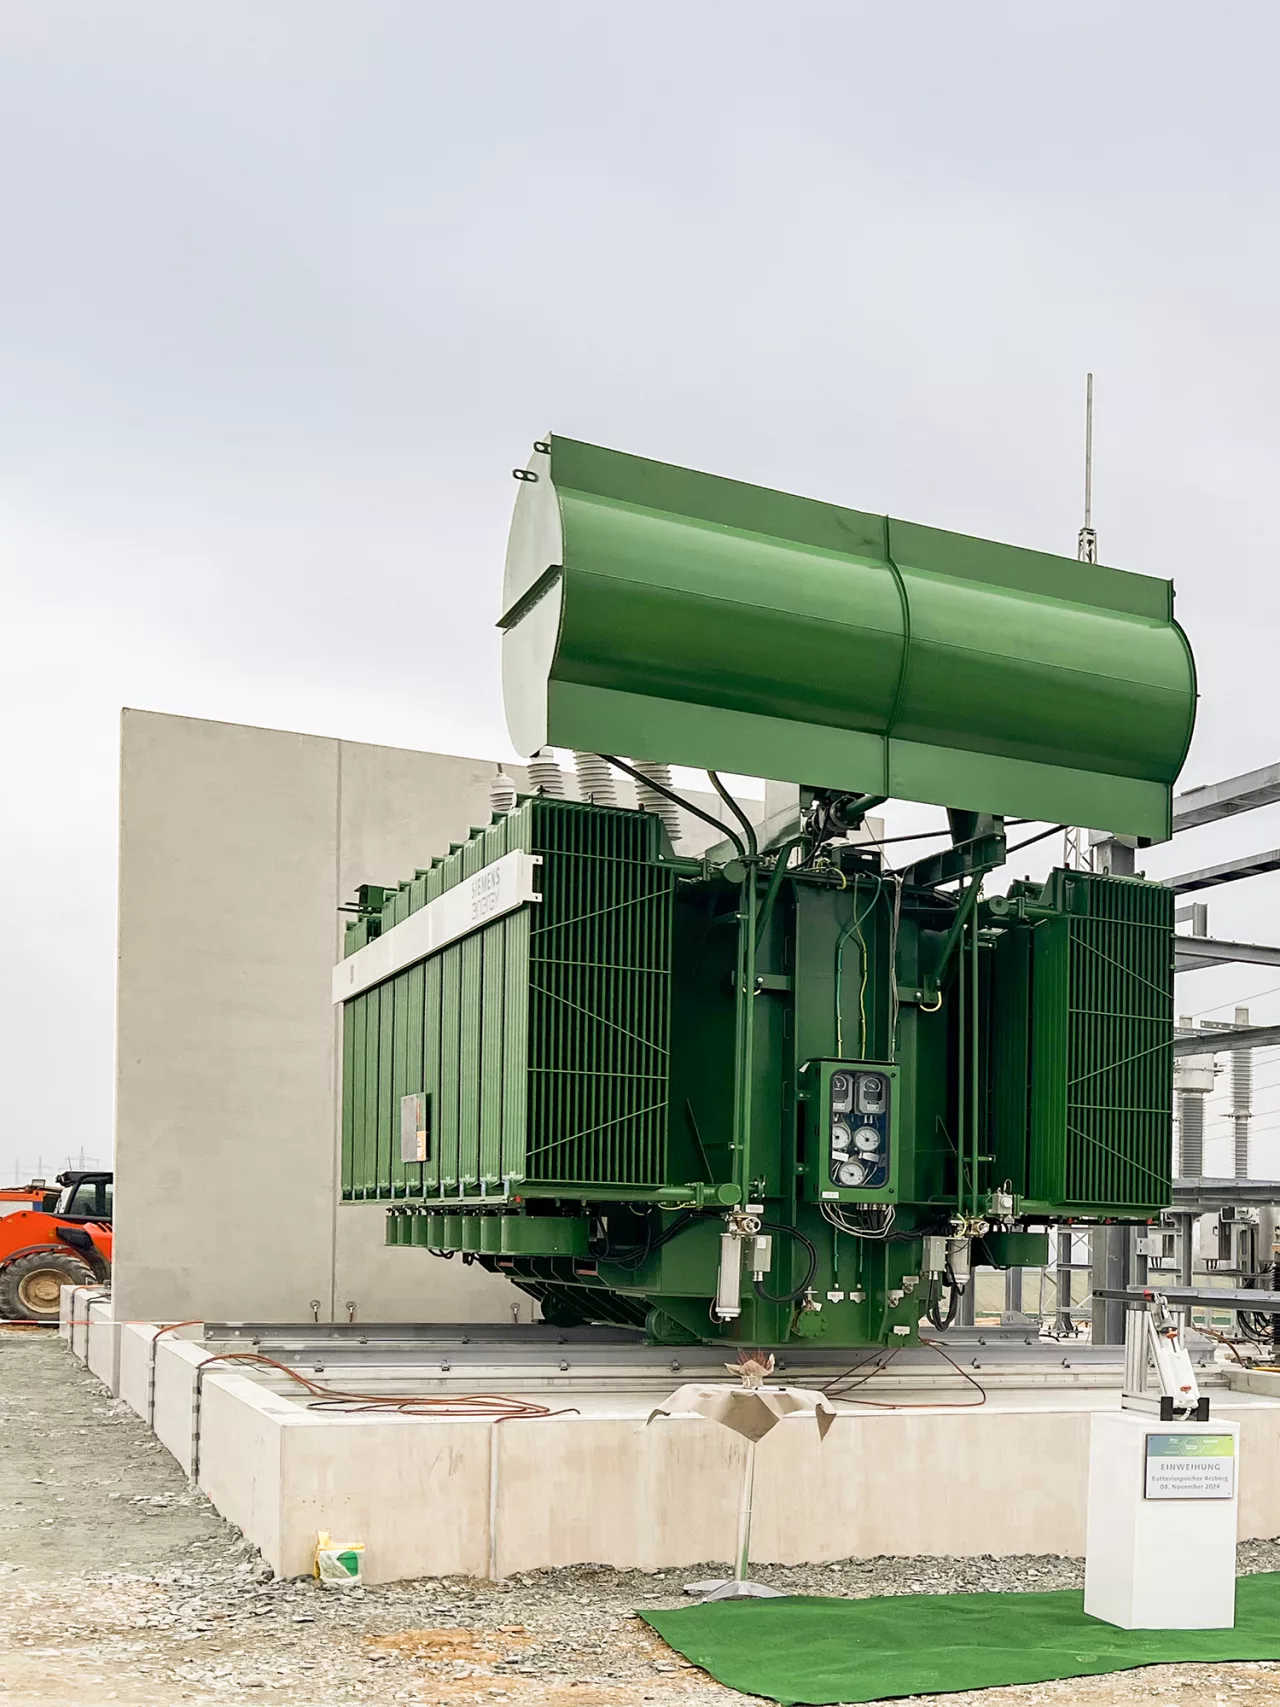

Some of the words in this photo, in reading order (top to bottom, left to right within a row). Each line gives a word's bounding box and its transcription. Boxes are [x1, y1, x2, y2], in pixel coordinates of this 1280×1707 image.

[471, 867, 501, 899] SIEMENS
[1160, 1463, 1221, 1471] EINWEIHUNG
[1151, 1475, 1203, 1483] Batteriespeicher
[1204, 1475, 1229, 1483] Arzberg
